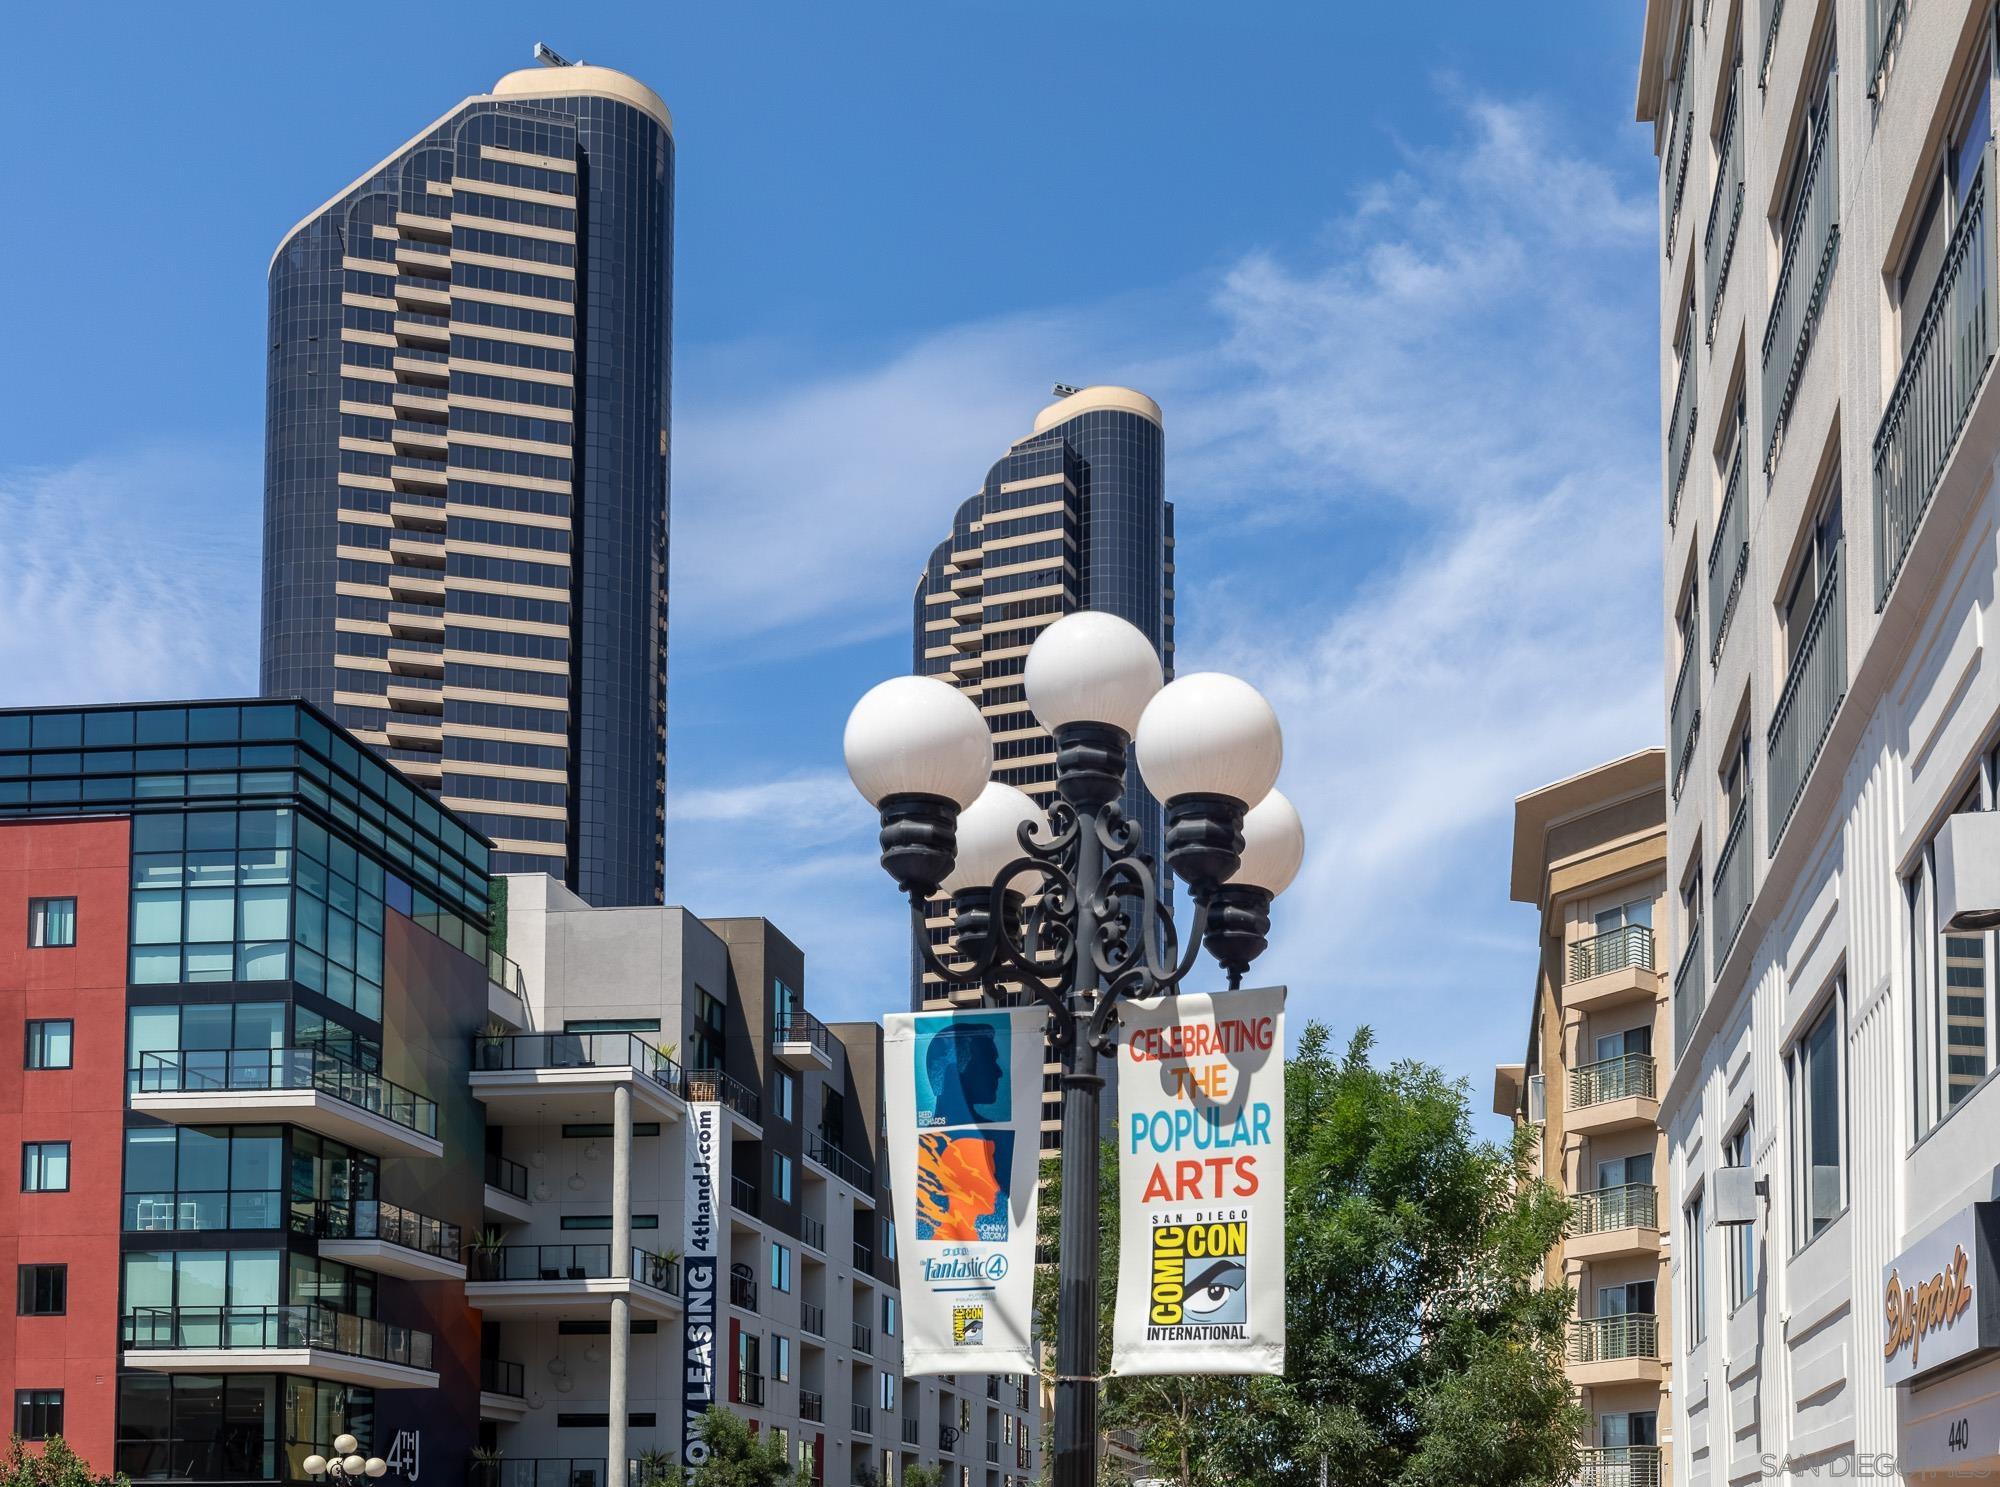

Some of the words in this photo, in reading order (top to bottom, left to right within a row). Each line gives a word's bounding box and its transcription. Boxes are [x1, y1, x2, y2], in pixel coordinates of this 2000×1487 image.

[1129, 1016, 1273, 1063] CELEBRATING
[1170, 1063, 1228, 1100] THE
[1131, 1102, 1272, 1155] POPULAR
[692, 1110, 712, 1251] 4thandJ.com
[1141, 1155, 1259, 1203] ARTS
[1152, 1213, 1183, 1225] SAN
[1196, 1209, 1248, 1222] DIEGO
[1186, 1222, 1246, 1258] CON
[924, 1256, 985, 1281] Fantastic
[988, 1256, 1004, 1278] 4
[1151, 1226, 1185, 1325] COMIC
[966, 1309, 983, 1319] CON
[687, 1266, 713, 1400] LEASING
[1147, 1325, 1248, 1341] INTERNATIONAL
[1949, 1418, 1969, 1452] 440
